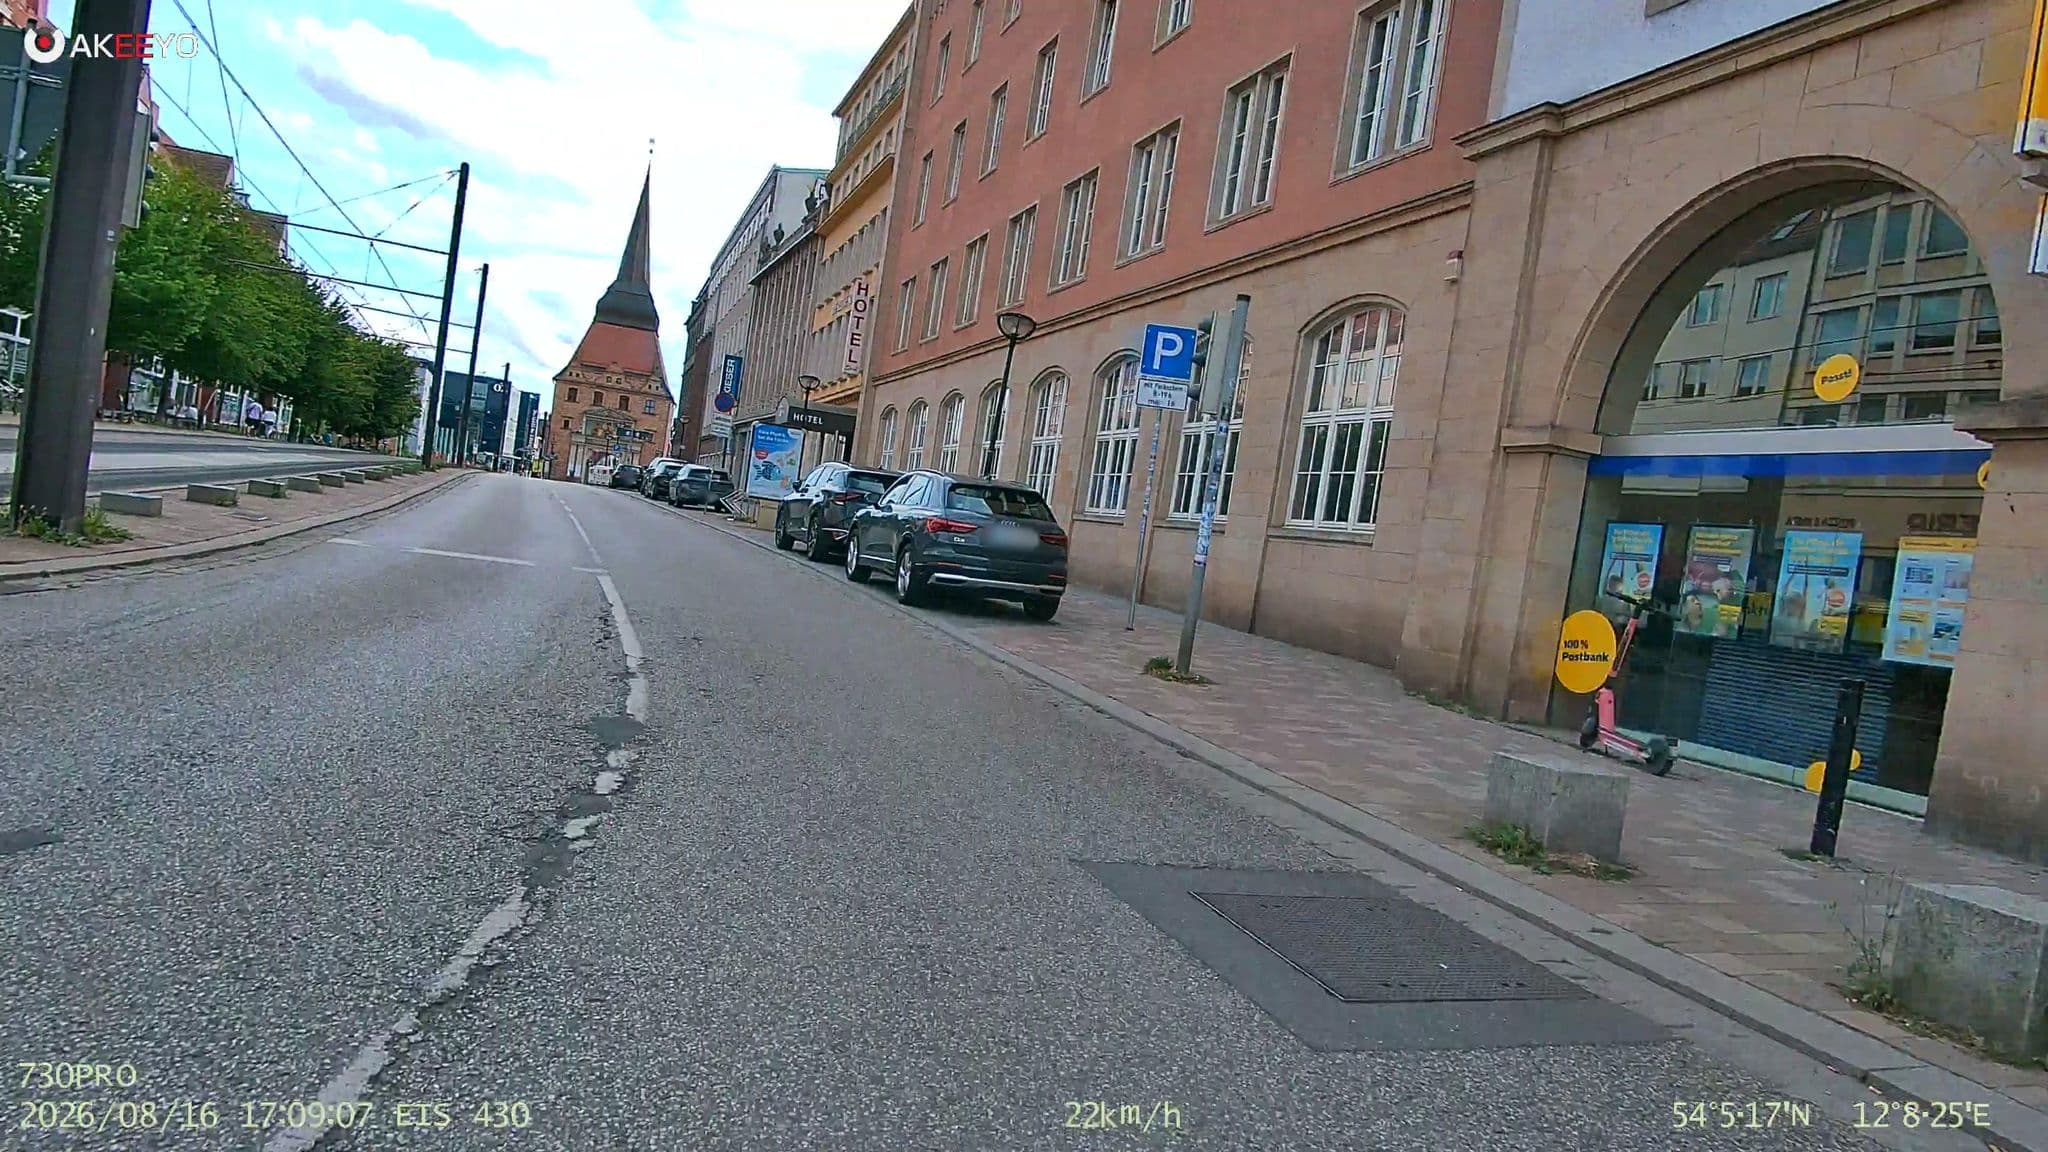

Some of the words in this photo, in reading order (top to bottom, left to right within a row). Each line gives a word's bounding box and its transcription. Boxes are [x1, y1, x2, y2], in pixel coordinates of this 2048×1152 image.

[848, 282, 869, 364] HOTEL
[1153, 331, 1184, 370] P
[1562, 651, 1609, 662] Postbank
